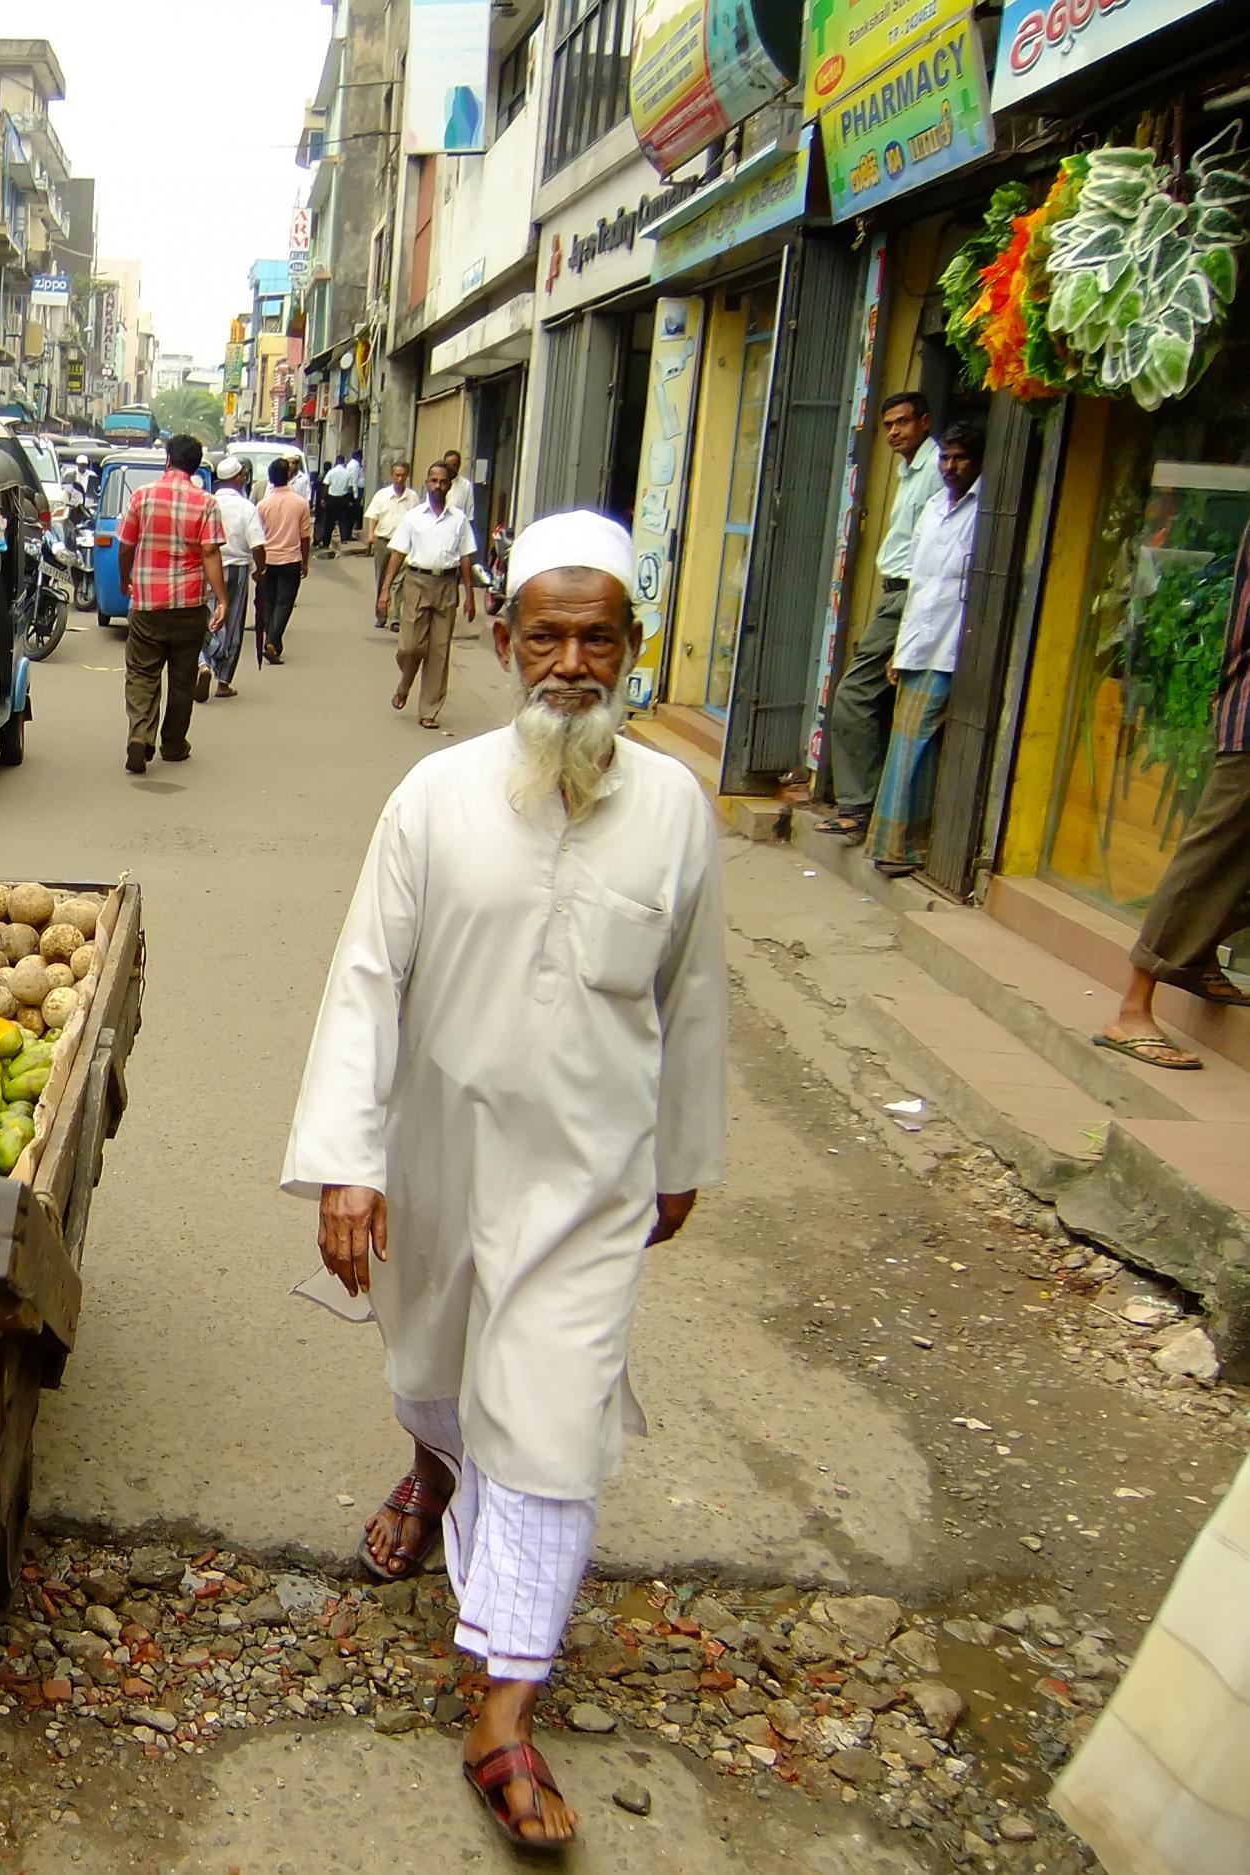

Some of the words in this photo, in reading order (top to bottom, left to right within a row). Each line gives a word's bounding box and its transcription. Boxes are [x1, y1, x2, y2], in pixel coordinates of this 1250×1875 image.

[849, 2, 891, 47] Bankshall
[841, 33, 965, 145] PHARMACY
[34, 279, 67, 291] zippo
